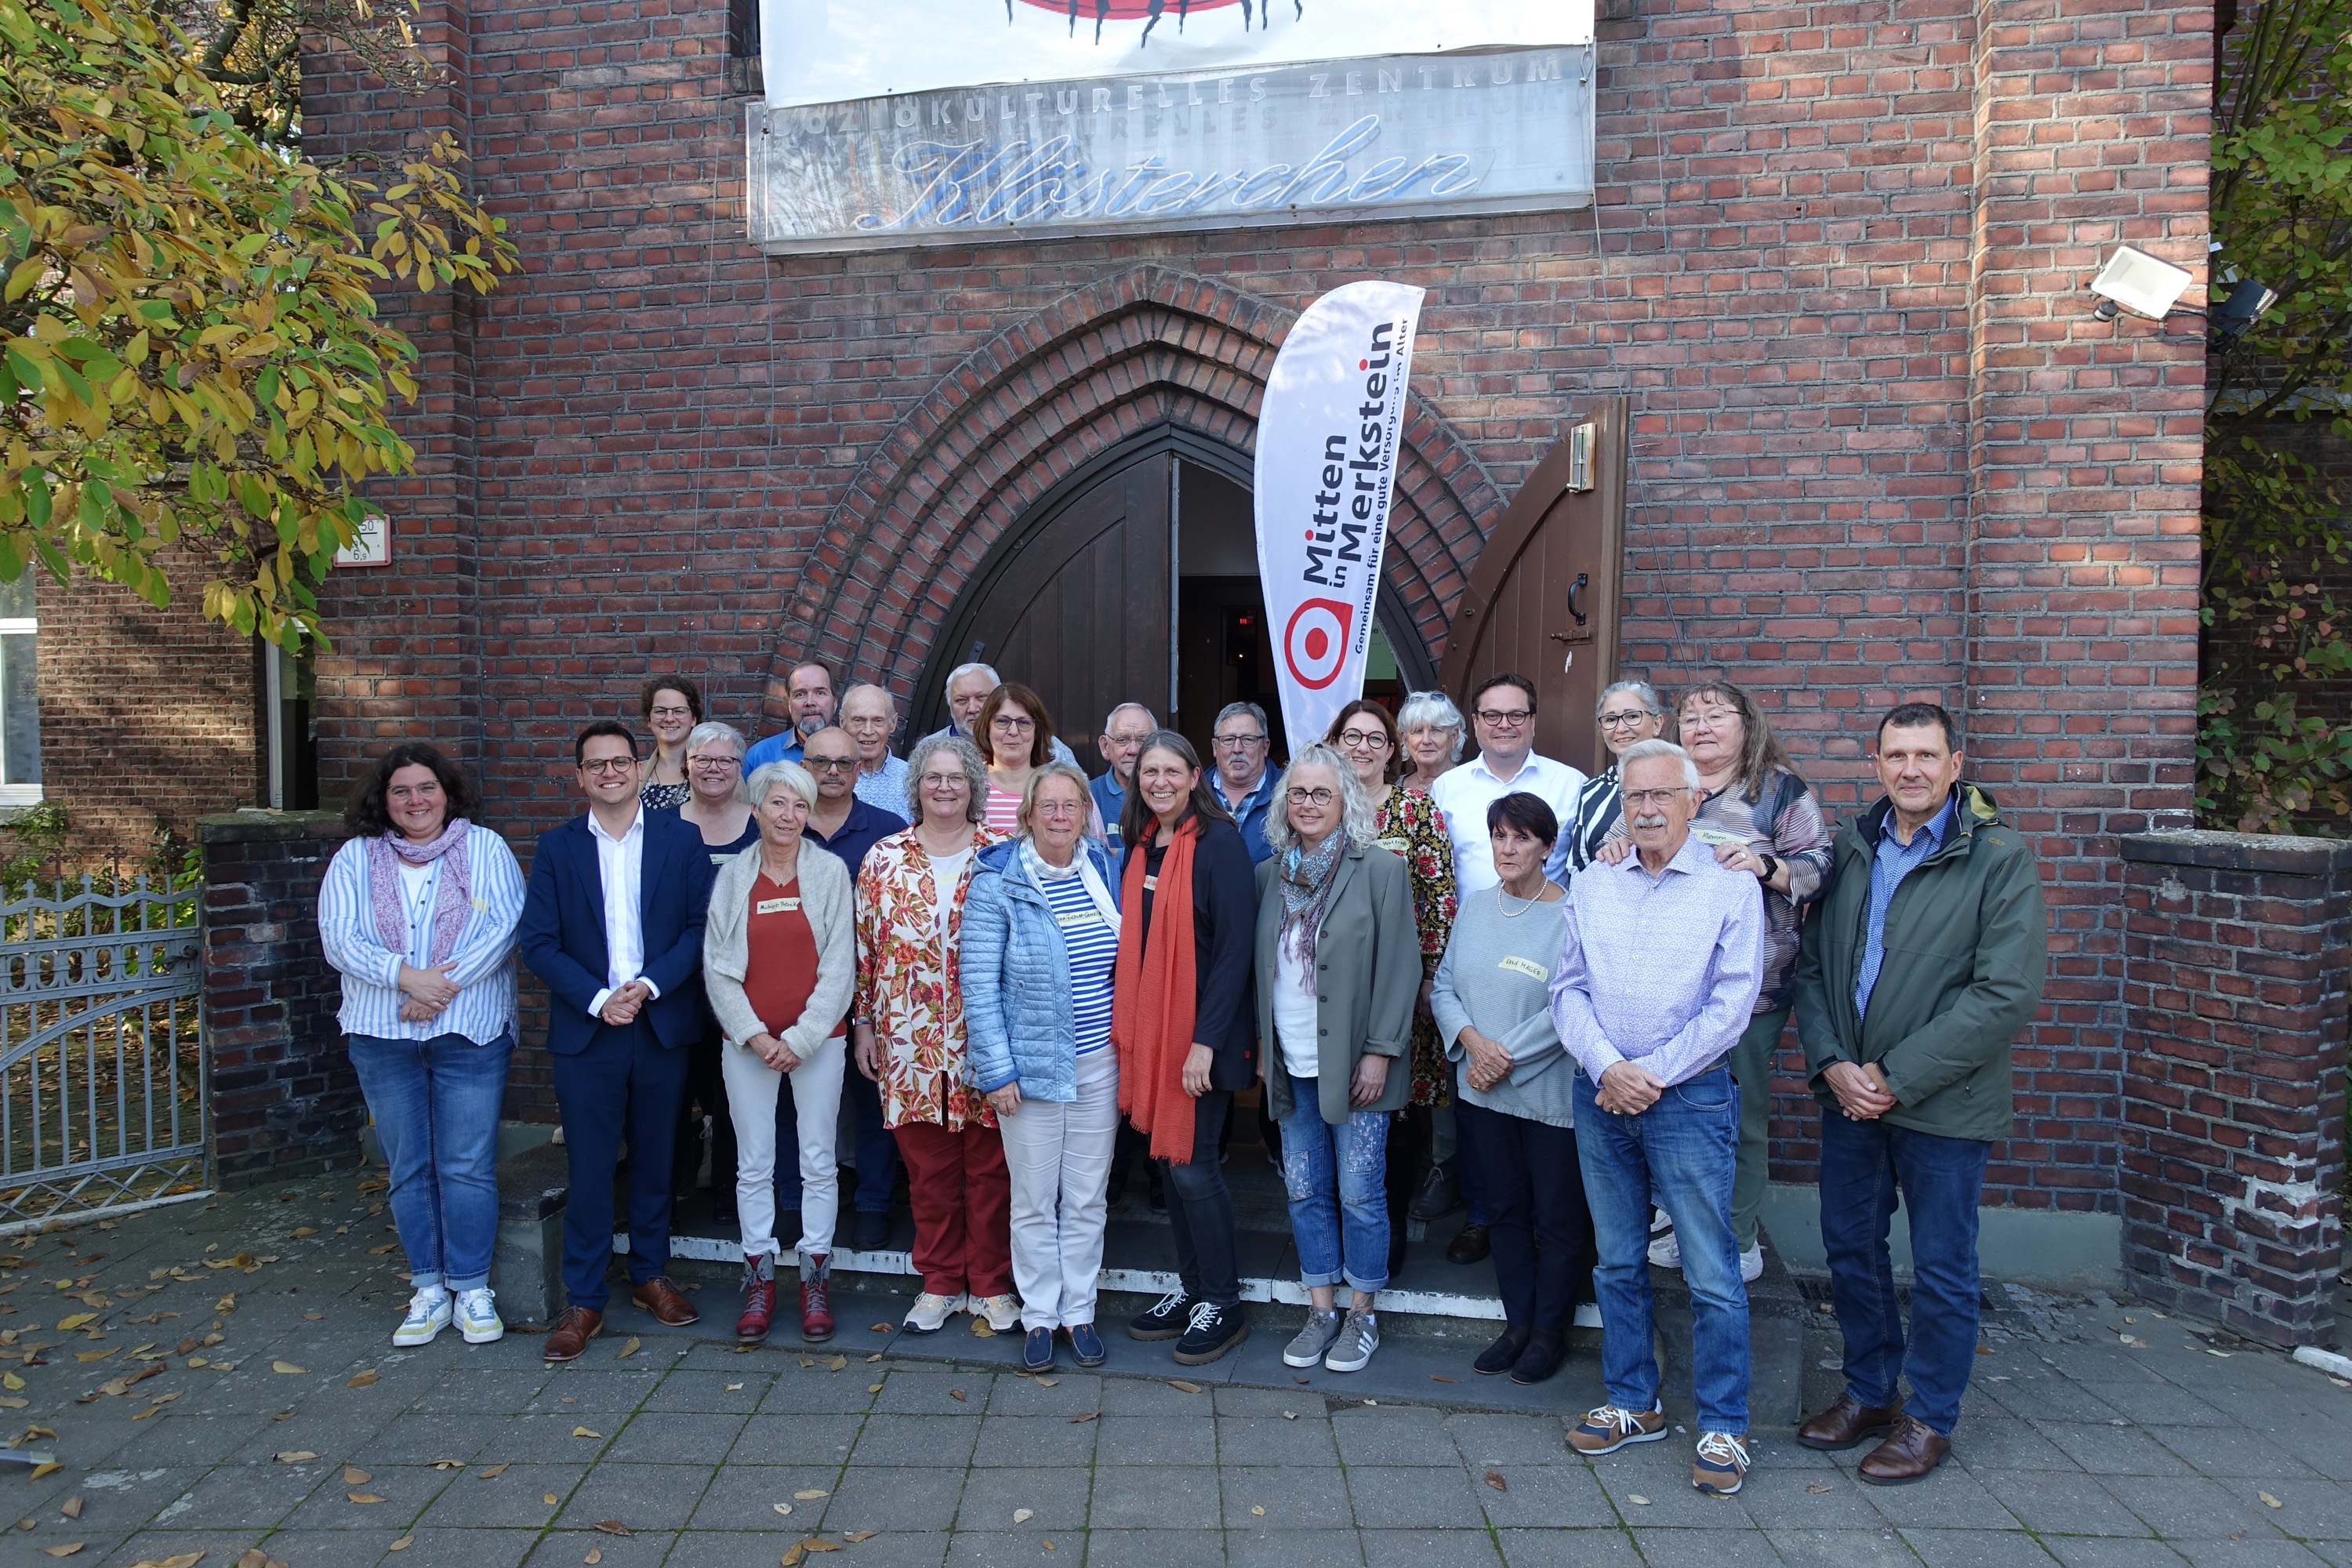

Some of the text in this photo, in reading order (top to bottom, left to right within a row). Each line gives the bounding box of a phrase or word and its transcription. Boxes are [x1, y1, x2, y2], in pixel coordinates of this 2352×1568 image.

[1308, 53, 1562, 98] ZENTRUM
[1396, 318, 1408, 357] Alter
[1329, 322, 1394, 589] in Merkstein
[1303, 435, 1347, 586] Mitten
[1377, 476, 1388, 510] gute
[1371, 514, 1384, 544] eine
[1367, 548, 1379, 569] für
[1355, 573, 1376, 655] Gemeinsam
